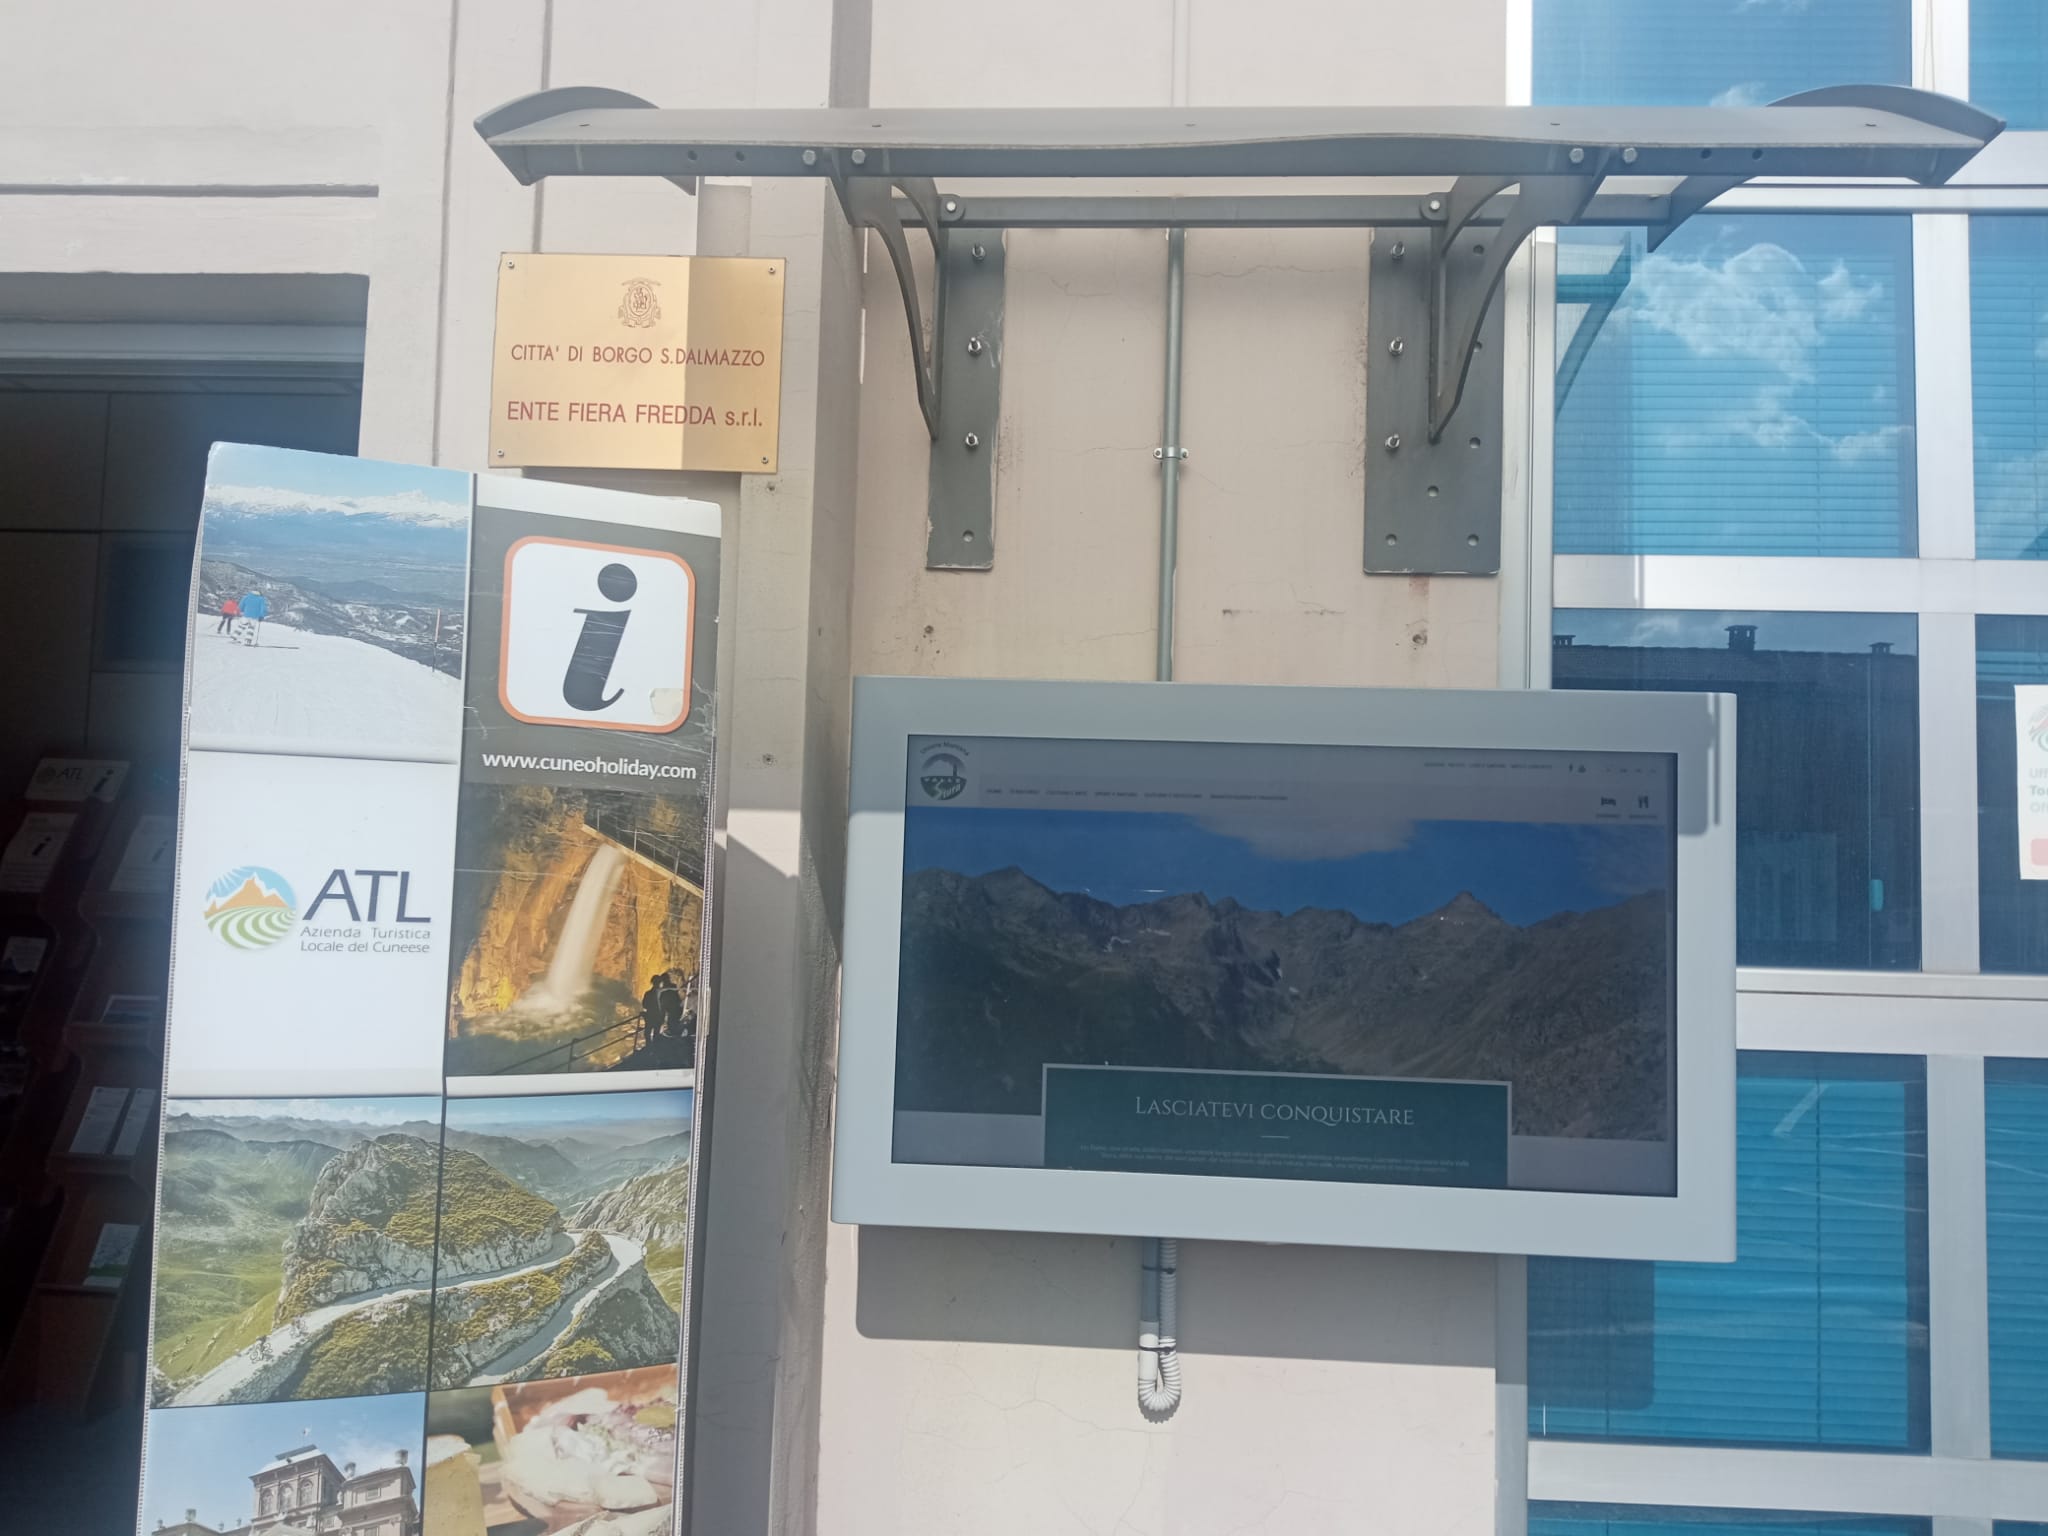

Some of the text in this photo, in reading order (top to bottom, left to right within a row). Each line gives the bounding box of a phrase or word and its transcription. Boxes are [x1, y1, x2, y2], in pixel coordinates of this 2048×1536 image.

[511, 344, 765, 367] CITTA' DI BORGO S.DALMAZZO
[507, 401, 763, 427] ENTE FIERA FREDDA s.r.l.
[482, 753, 697, 779] www.cuneoholiday.com
[2029, 785, 2048, 796] To
[302, 869, 431, 923] ATL
[300, 926, 431, 939] Azienda Turistica
[300, 941, 430, 953] Locale del Cuneese
[1260, 1103, 1415, 1127] CONQUISTARE
